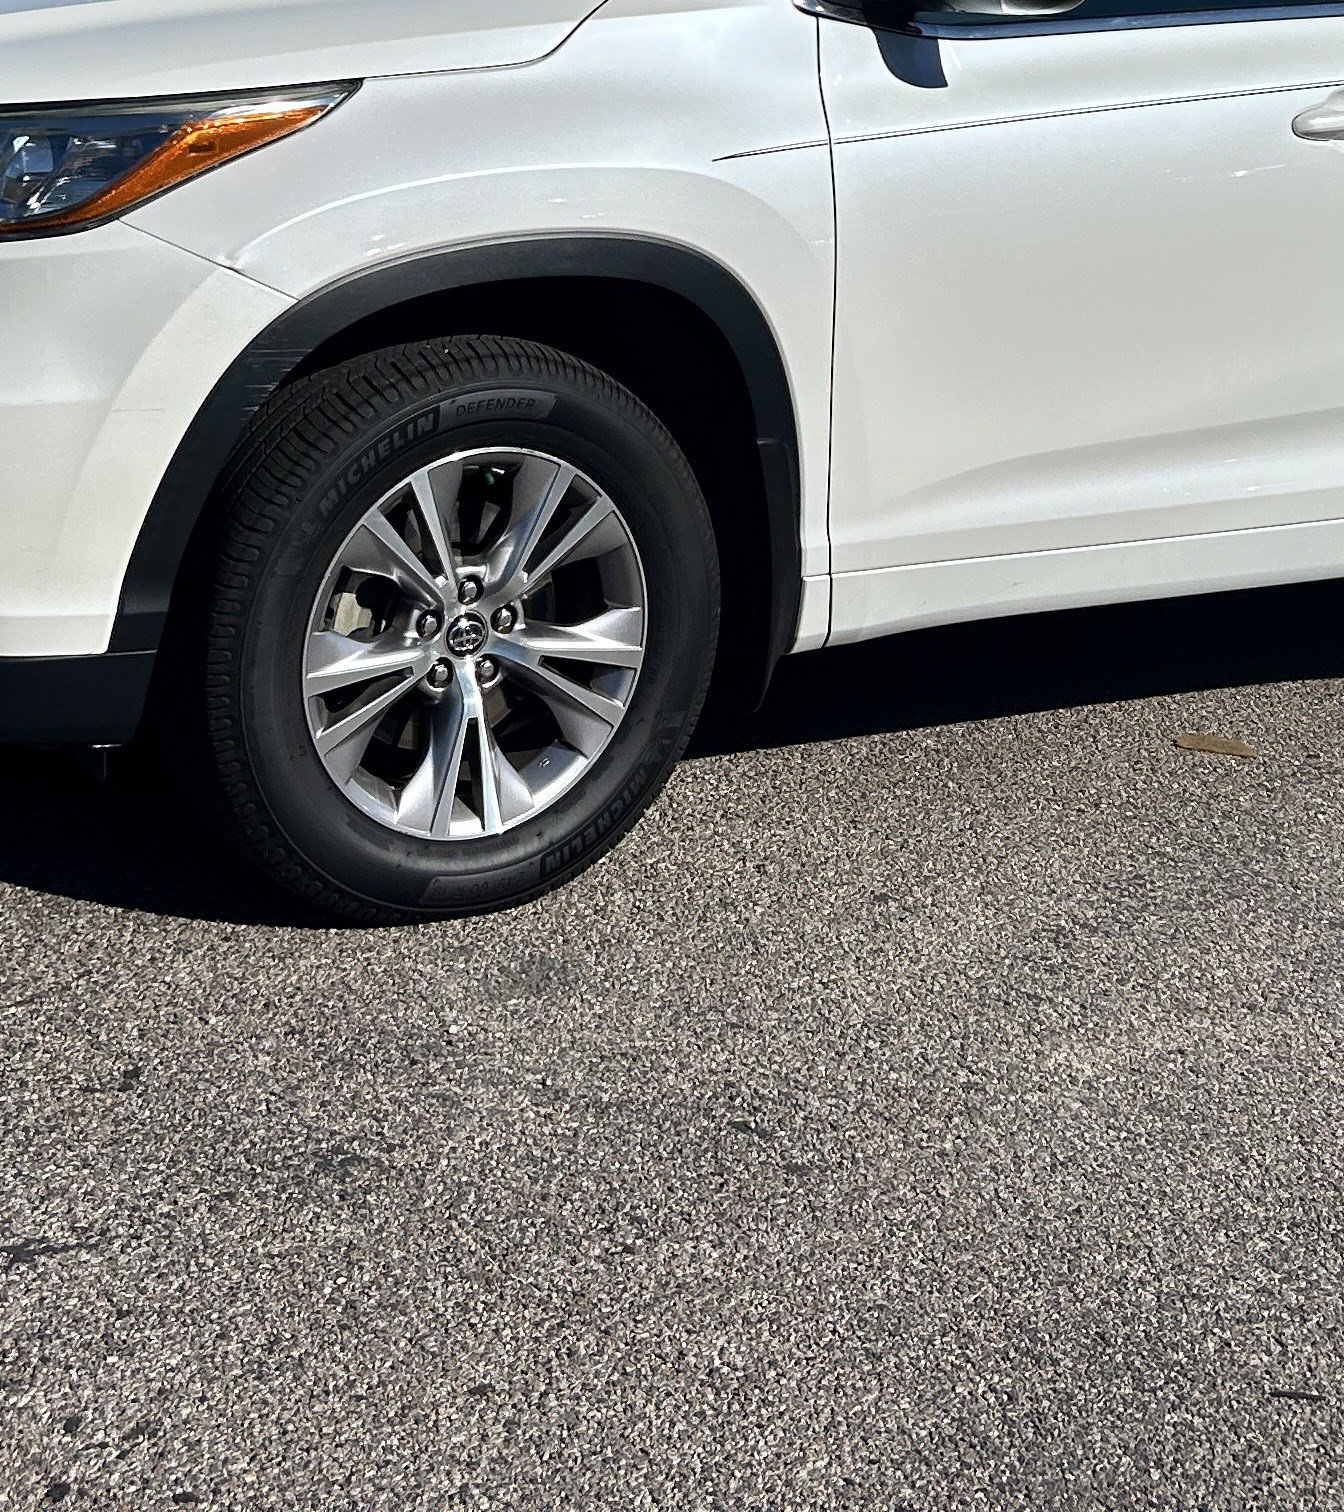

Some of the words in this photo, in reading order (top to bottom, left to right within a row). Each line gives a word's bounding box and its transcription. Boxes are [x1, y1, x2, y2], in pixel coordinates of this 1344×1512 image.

[319, 412, 436, 517] MICHELIN
[456, 396, 536, 416] DEFENDER
[543, 765, 649, 872] MICHELIN
